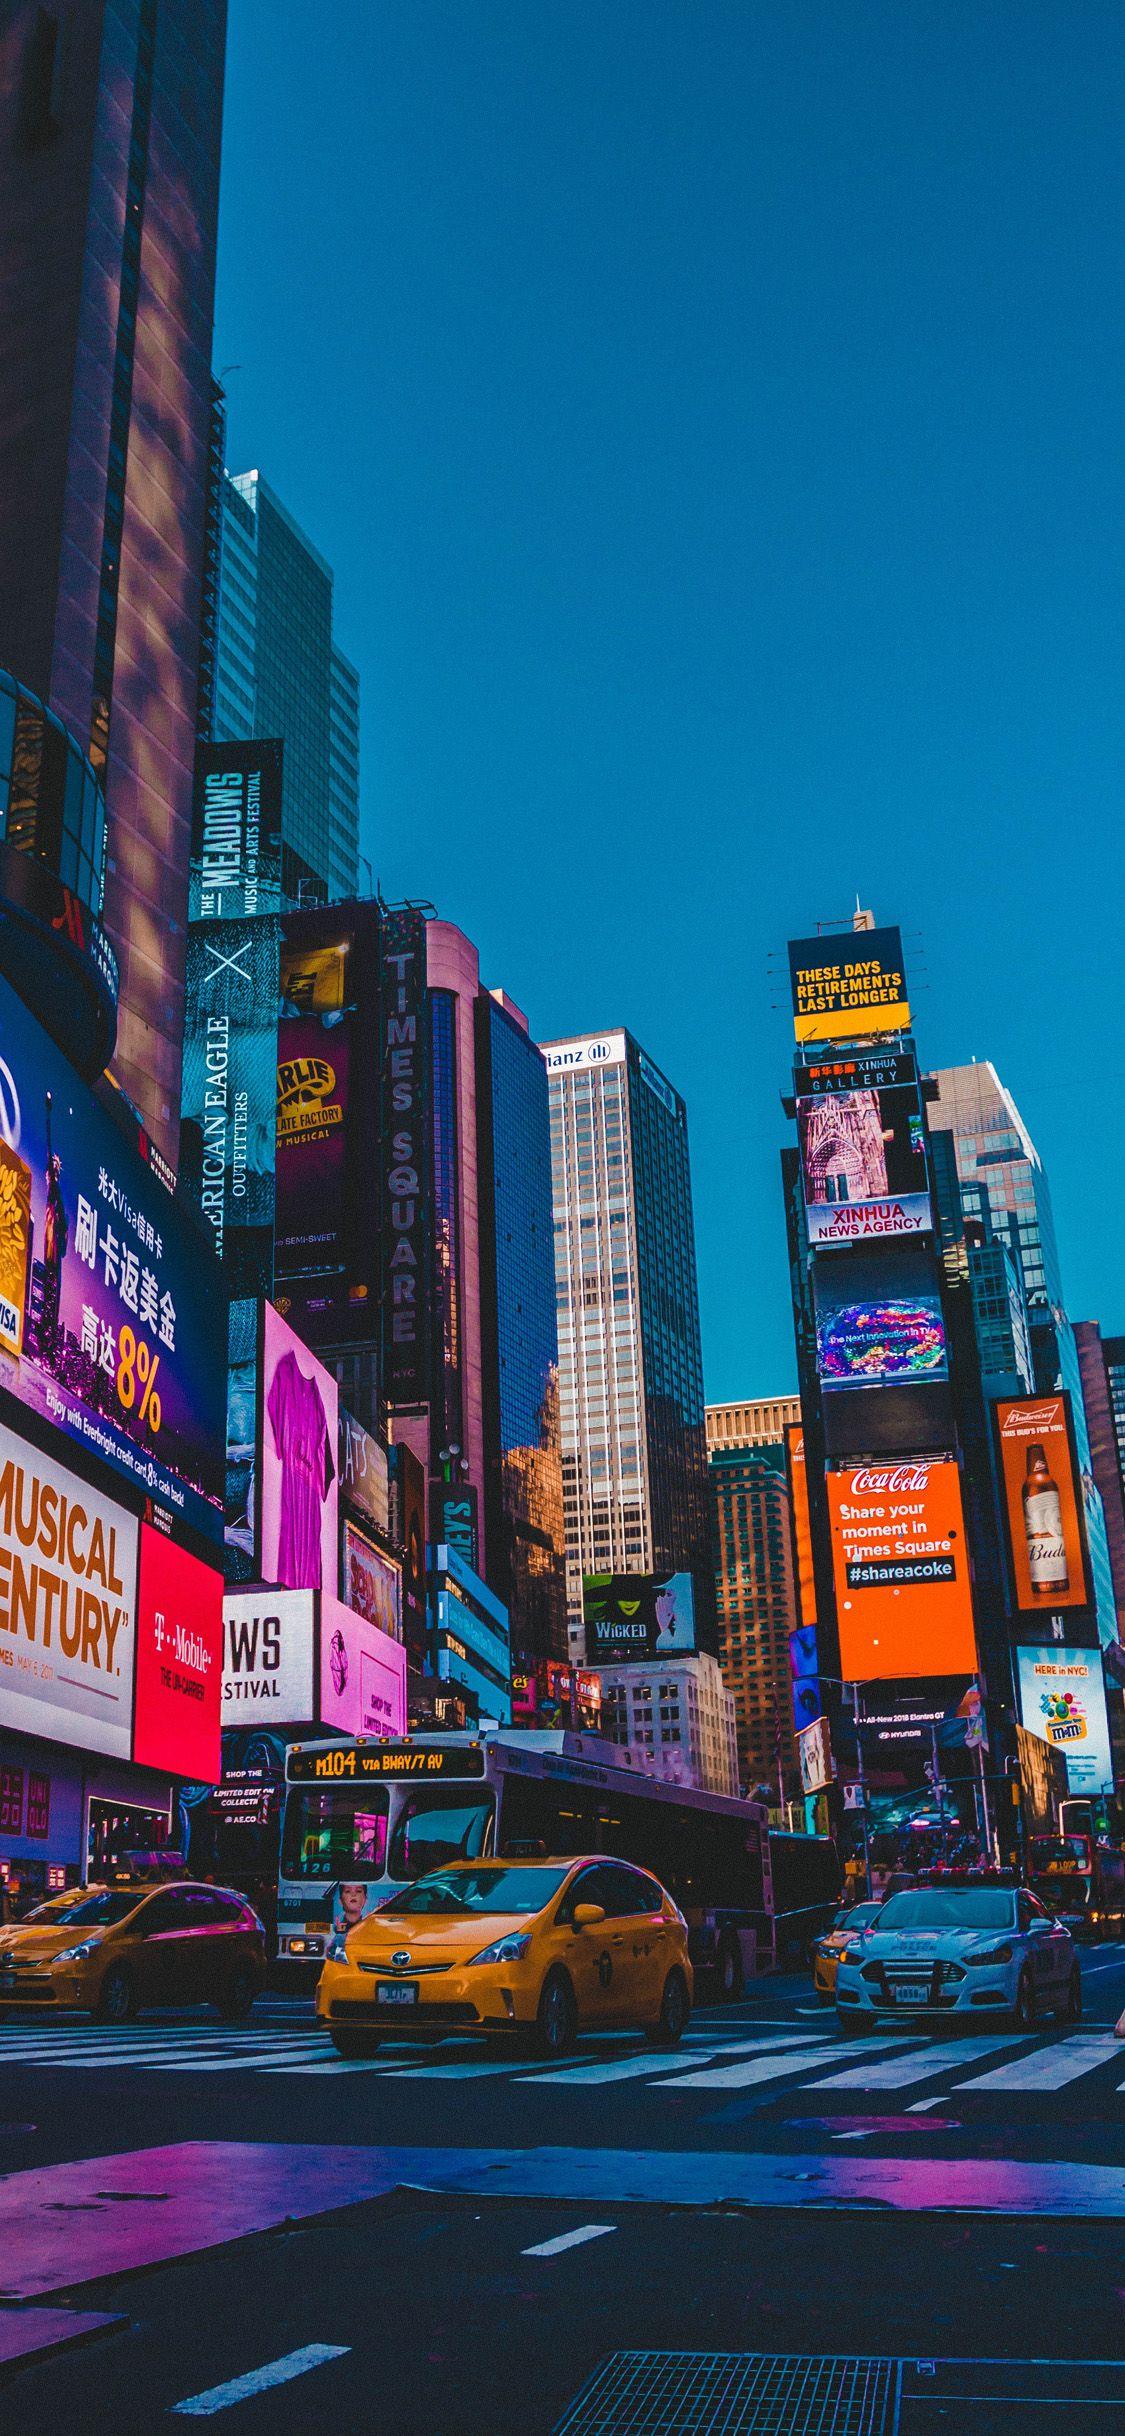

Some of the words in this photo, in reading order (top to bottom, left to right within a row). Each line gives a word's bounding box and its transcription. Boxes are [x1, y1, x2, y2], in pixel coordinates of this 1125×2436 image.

[246, 771, 261, 823] FESTIVAL
[202, 772, 243, 887] MEADOWS
[246, 822, 259, 856] ARTS
[200, 892, 215, 916] THE
[244, 877, 259, 914] MUSIC
[796, 965, 841, 983] THESE
[843, 960, 881, 978] DAYS
[796, 972, 903, 999] RETIREMENTS
[797, 995, 835, 1013] LAST
[839, 987, 900, 1009] LONGER
[386, 952, 417, 1111] TIMES
[204, 1015, 229, 1108] EAGLE
[858, 1058, 897, 1072] XINHUA
[812, 1071, 898, 1091] GALLERY
[299, 1108, 340, 1128] FACTORY
[232, 1091, 248, 1197] OUTFITTERS
[286, 1129, 330, 1146] MUSICAL
[832, 1203, 906, 1225] XINHUA
[285, 1232, 337, 1245] SEMI-SWEET
[388, 1131, 420, 1343] SQUARE
[818, 1222, 862, 1239] NEWS
[862, 1216, 923, 1235] AGENCY
[74, 1194, 177, 1352] 刷卡返美金
[845, 1334, 865, 1343] Next
[866, 1329, 909, 1341] Innovation
[1008, 1411, 1054, 1424] Budweiser
[46, 1388, 67, 1421] Enjoy
[67, 1408, 82, 1430] with
[83, 1417, 116, 1456] Everbright
[116, 1449, 134, 1469] credit
[158, 1479, 171, 1497] cash
[1001, 1430, 1016, 1438] THIS
[1016, 1427, 1036, 1436] BUD'S
[1036, 1425, 1049, 1434] FOR
[850, 1464, 932, 1495] Coca-Cola
[840, 1504, 885, 1520] Share
[889, 1502, 925, 1518] your
[841, 1523, 908, 1540] moment
[912, 1520, 927, 1534] in
[843, 1543, 891, 1559] Times
[895, 1539, 951, 1556] Square
[849, 1561, 953, 1582] #shareacoke
[1035, 1665, 1057, 1675] HERE
[1058, 1666, 1066, 1675] in
[1067, 1667, 1088, 1676] NYC!
[866, 1715, 893, 1724] All-New
[893, 1714, 909, 1723] 2018
[934, 1711, 945, 1719] GT
[890, 1730, 922, 1738] HYUNDAI
[225, 1770, 246, 1779] SHOP
[247, 1769, 263, 1777] THE
[315, 1751, 356, 1776] M104
[362, 1759, 380, 1771] VIA
[382, 1753, 425, 1771] BWAY/7
[427, 1754, 443, 1770] AV
[213, 1789, 243, 1798] LIMITED
